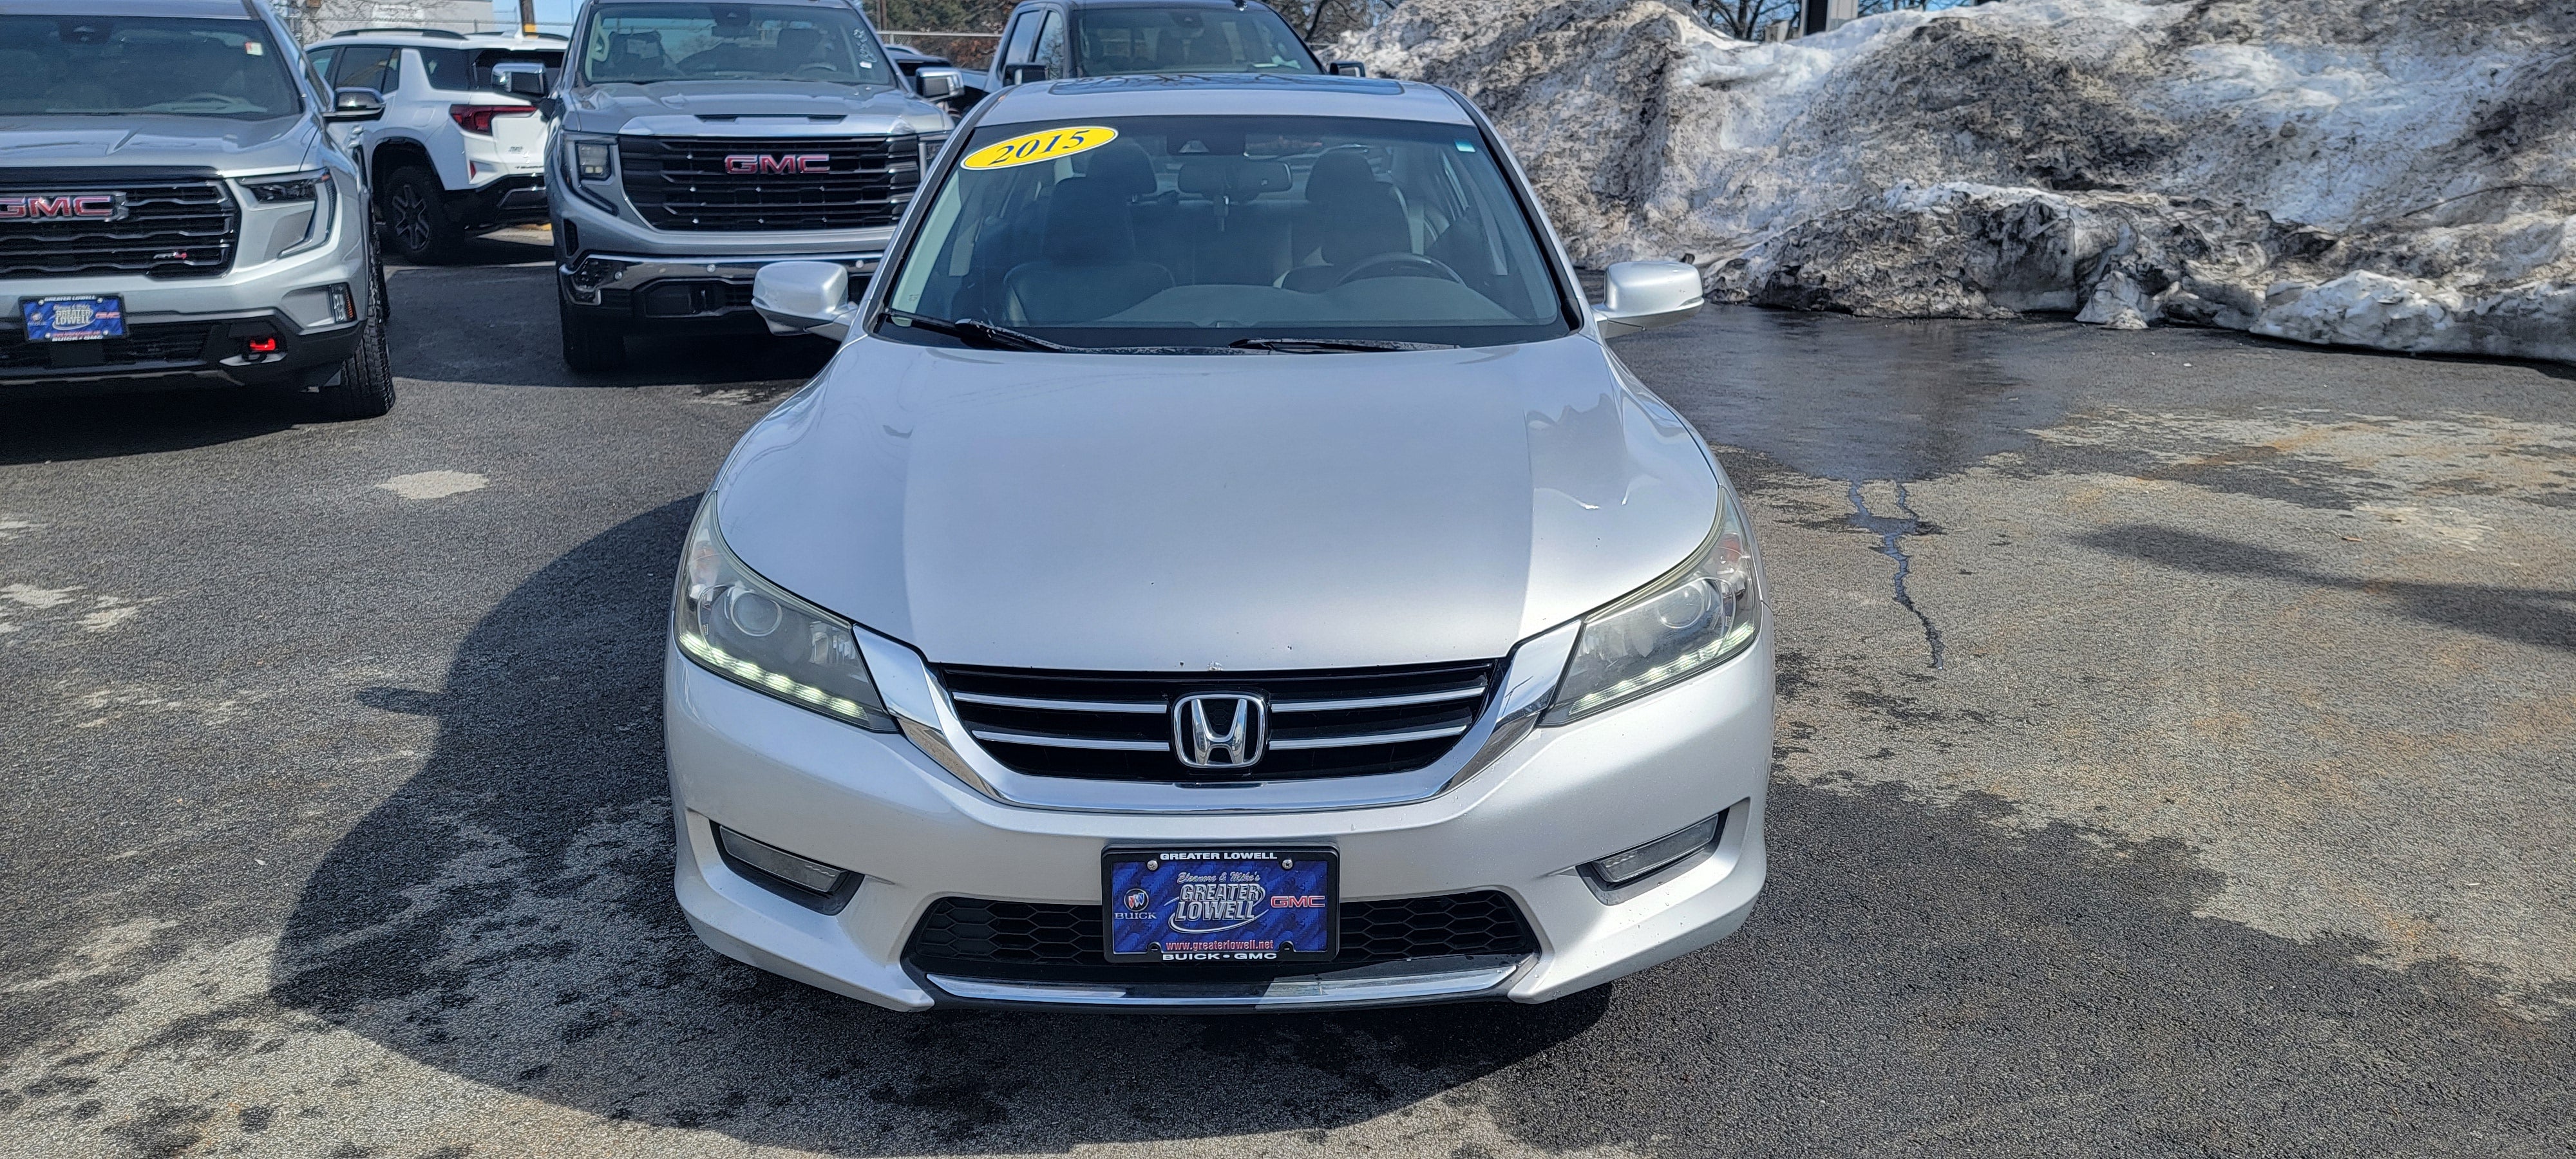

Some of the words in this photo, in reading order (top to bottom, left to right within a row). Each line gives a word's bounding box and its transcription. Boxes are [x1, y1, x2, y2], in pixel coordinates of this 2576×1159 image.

[988, 130, 1090, 165] 2015
[724, 154, 830, 174] GMC
[0, 196, 113, 218] GMC
[1224, 852, 1277, 860] LOWELL
[1219, 871, 1227, 882] &
[1230, 871, 1261, 882] Mike's
[1180, 883, 1261, 902] GREATER
[1271, 896, 1325, 908] GMC
[1175, 901, 1255, 921] LOWELL
[1166, 940, 1274, 952] www.greaterlowell.net
